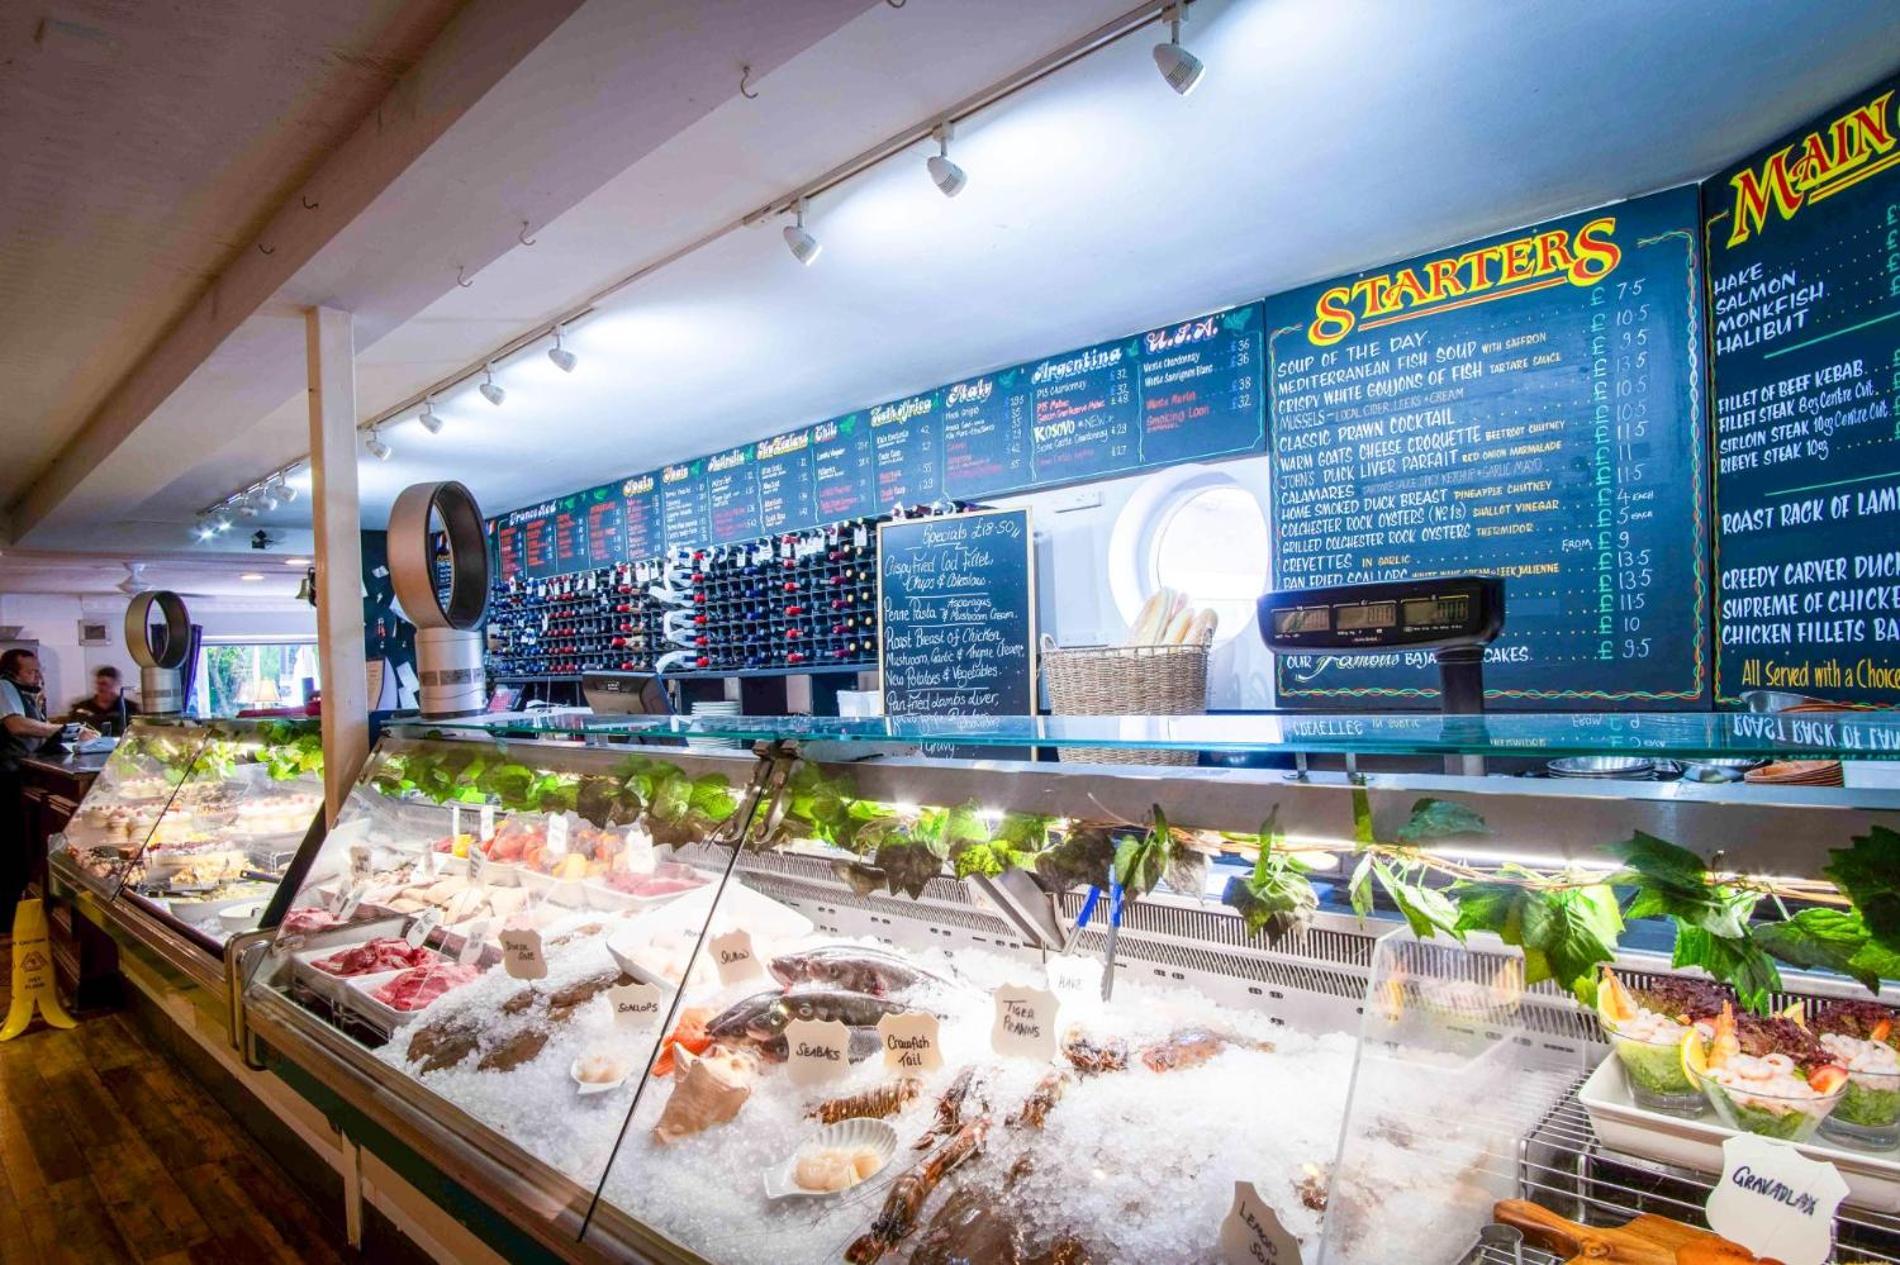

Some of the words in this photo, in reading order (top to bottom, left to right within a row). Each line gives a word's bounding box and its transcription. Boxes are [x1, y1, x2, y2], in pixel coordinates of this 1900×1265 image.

[1726, 89, 1897, 250] MAIN
[1308, 217, 1622, 346] STARTERS
[1714, 262, 1763, 296] HAKE
[1716, 270, 1796, 315] SALMON
[1716, 281, 1824, 335] MONKFISH
[1716, 308, 1809, 356] HALIBUT
[1031, 347, 1122, 384] Argentina
[1278, 355, 1315, 378] SOUP
[1321, 351, 1339, 367] OF
[1346, 341, 1381, 363] THE
[1390, 330, 1429, 353] DAY
[1278, 359, 1390, 396] MEDITERRANEAN
[1398, 352, 1427, 371] FISH
[1436, 341, 1477, 363] SOUP
[1481, 340, 1502, 354] WITH
[1278, 394, 1319, 415] CRISPY
[1324, 384, 1362, 406] WHITE
[1367, 372, 1424, 398] GOUJONS
[1428, 368, 1446, 386] OF
[1451, 360, 1483, 382] FISH
[1718, 389, 1758, 414] FILLET
[1761, 383, 1776, 403] OF
[1778, 374, 1811, 398] BEEF
[1815, 359, 1863, 388] KEBAB
[1279, 429, 1331, 452] CLASSIC
[1338, 420, 1383, 442] PRAWN
[1390, 408, 1455, 435] COCKTAIL
[1718, 412, 1757, 433] FILLET
[1759, 399, 1795, 423] STEAK
[1280, 454, 1313, 473] WARM
[1318, 446, 1353, 467] GOATS
[1359, 439, 1402, 461] CHEESE
[1407, 425, 1481, 454] CROQUETTE
[1720, 430, 1766, 455] SIRLOIN
[1771, 420, 1810, 443] STEAK
[1323, 465, 1355, 484] DUCK
[1359, 459, 1397, 479] LIVER
[1401, 450, 1459, 473] PARFAIT
[1461, 453, 1480, 464] RED
[1720, 451, 1758, 474] RIBEYE
[1763, 443, 1802, 466] STEAK
[1281, 485, 1355, 506] CALAMARES
[1281, 505, 1312, 521] HOME
[1314, 500, 1360, 516] SMOKED
[1364, 495, 1396, 512] DUCK
[1400, 488, 1448, 507] BREAST
[1281, 516, 1342, 537] COLCHESTER
[1346, 514, 1372, 531] ROCK
[1378, 506, 1425, 527] OYSTERS
[1722, 507, 1774, 535] ROAST
[1780, 498, 1825, 527] RACK
[1830, 494, 1851, 519] OF
[1282, 538, 1322, 554] GRILLED
[1326, 532, 1384, 550] COLCHESTER
[1388, 529, 1416, 543] ROCK
[1422, 522, 1471, 541] OYSTERS
[1282, 553, 1353, 573] CREVETTES
[1361, 556, 1373, 568] IN
[1562, 539, 1592, 551] FROM
[1616, 531, 1630, 549] 9
[1722, 565, 1779, 590] CREEDY
[1784, 557, 1848, 585] CARVER
[1722, 593, 1799, 619] SUPREME
[1804, 592, 1824, 613] OF
[1624, 616, 1641, 633] 10
[1722, 623, 1791, 645] CHICKEN
[1797, 619, 1865, 643] FILLETS
[1742, 658, 1760, 687] All
[1765, 659, 1809, 688] Served
[1815, 657, 1841, 689] with
[1845, 671, 1853, 687] a
[1003, 1000, 1034, 1019] TIGER
[1003, 1014, 1040, 1038] PRAWNS
[796, 1042, 840, 1061] SEABASS
[898, 1052, 922, 1067] Tail
[1732, 1165, 1819, 1218] GRAVADLAX
